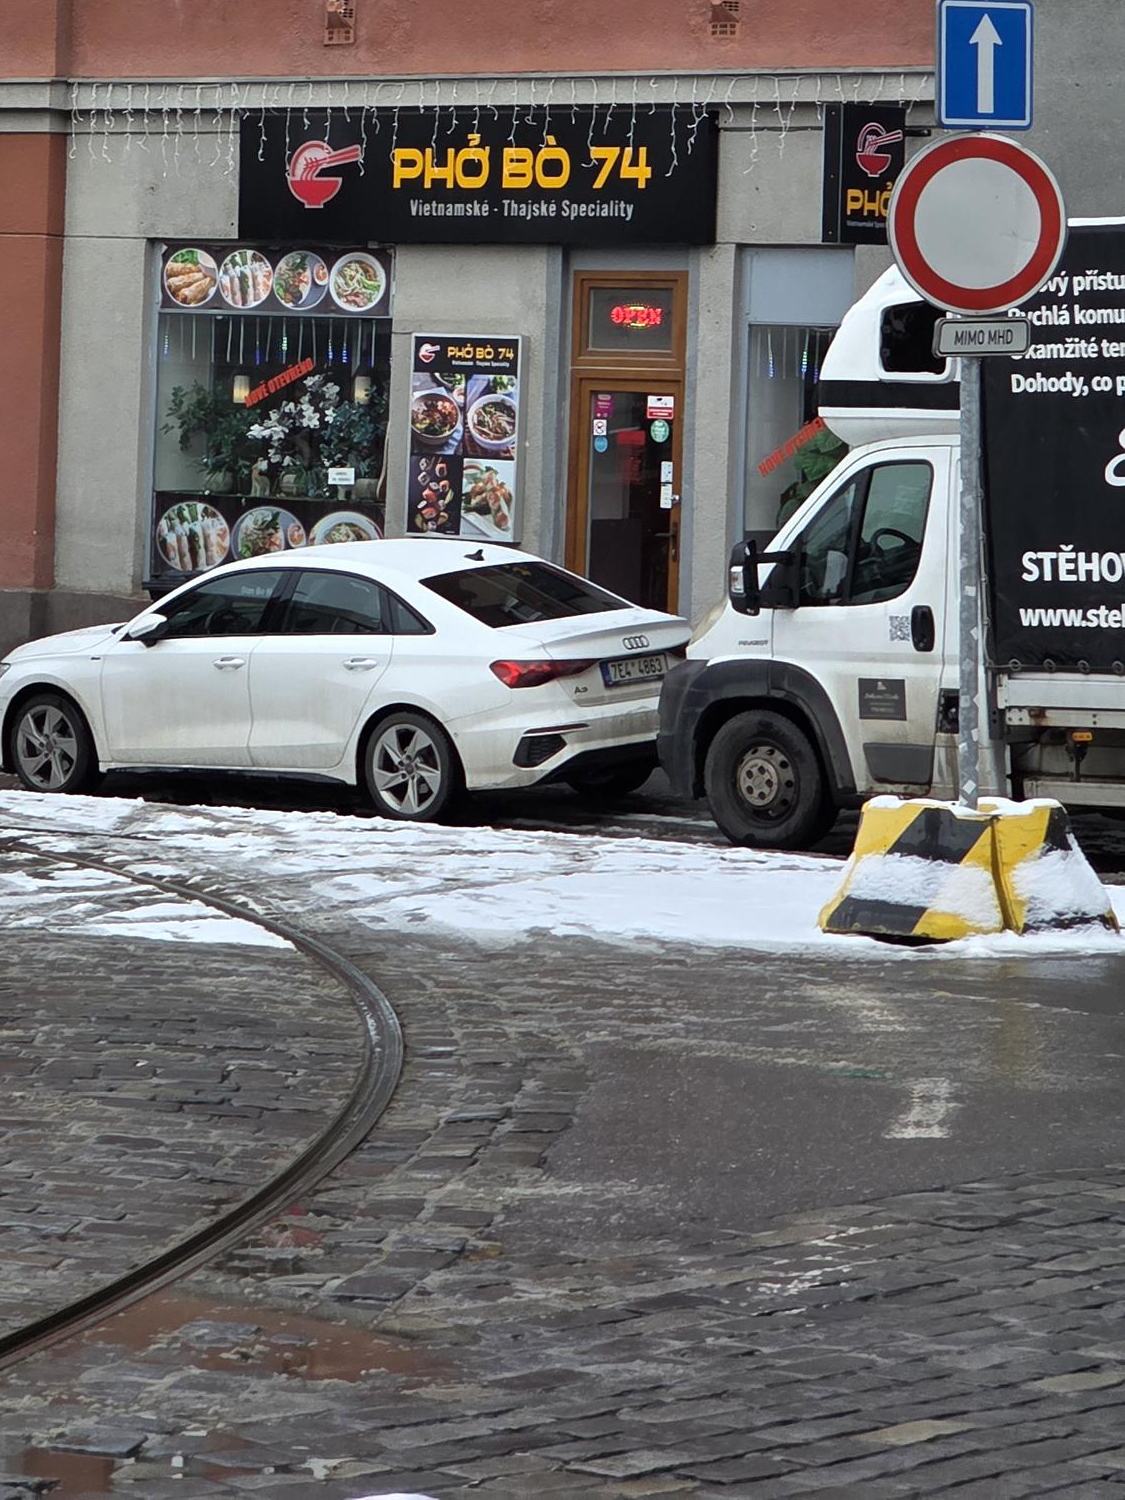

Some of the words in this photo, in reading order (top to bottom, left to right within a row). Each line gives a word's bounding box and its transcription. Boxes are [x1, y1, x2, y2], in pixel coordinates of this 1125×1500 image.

[393, 133, 490, 189] PHỞ
[502, 134, 571, 189] BÒ
[589, 146, 652, 189] 74
[410, 199, 489, 217] Vietnamské
[503, 199, 557, 220] Thajské
[561, 200, 634, 221] Speciality
[611, 305, 663, 326] OPEN
[1074, 304, 1125, 325] komu
[954, 330, 985, 346] MIMO
[988, 329, 1014, 346] MHD
[497, 347, 514, 360] 74
[1011, 337, 1099, 360] kamžité
[1011, 371, 1089, 397] Dohody,
[1091, 375, 1113, 392] co
[638, 658, 663, 675] 4863
